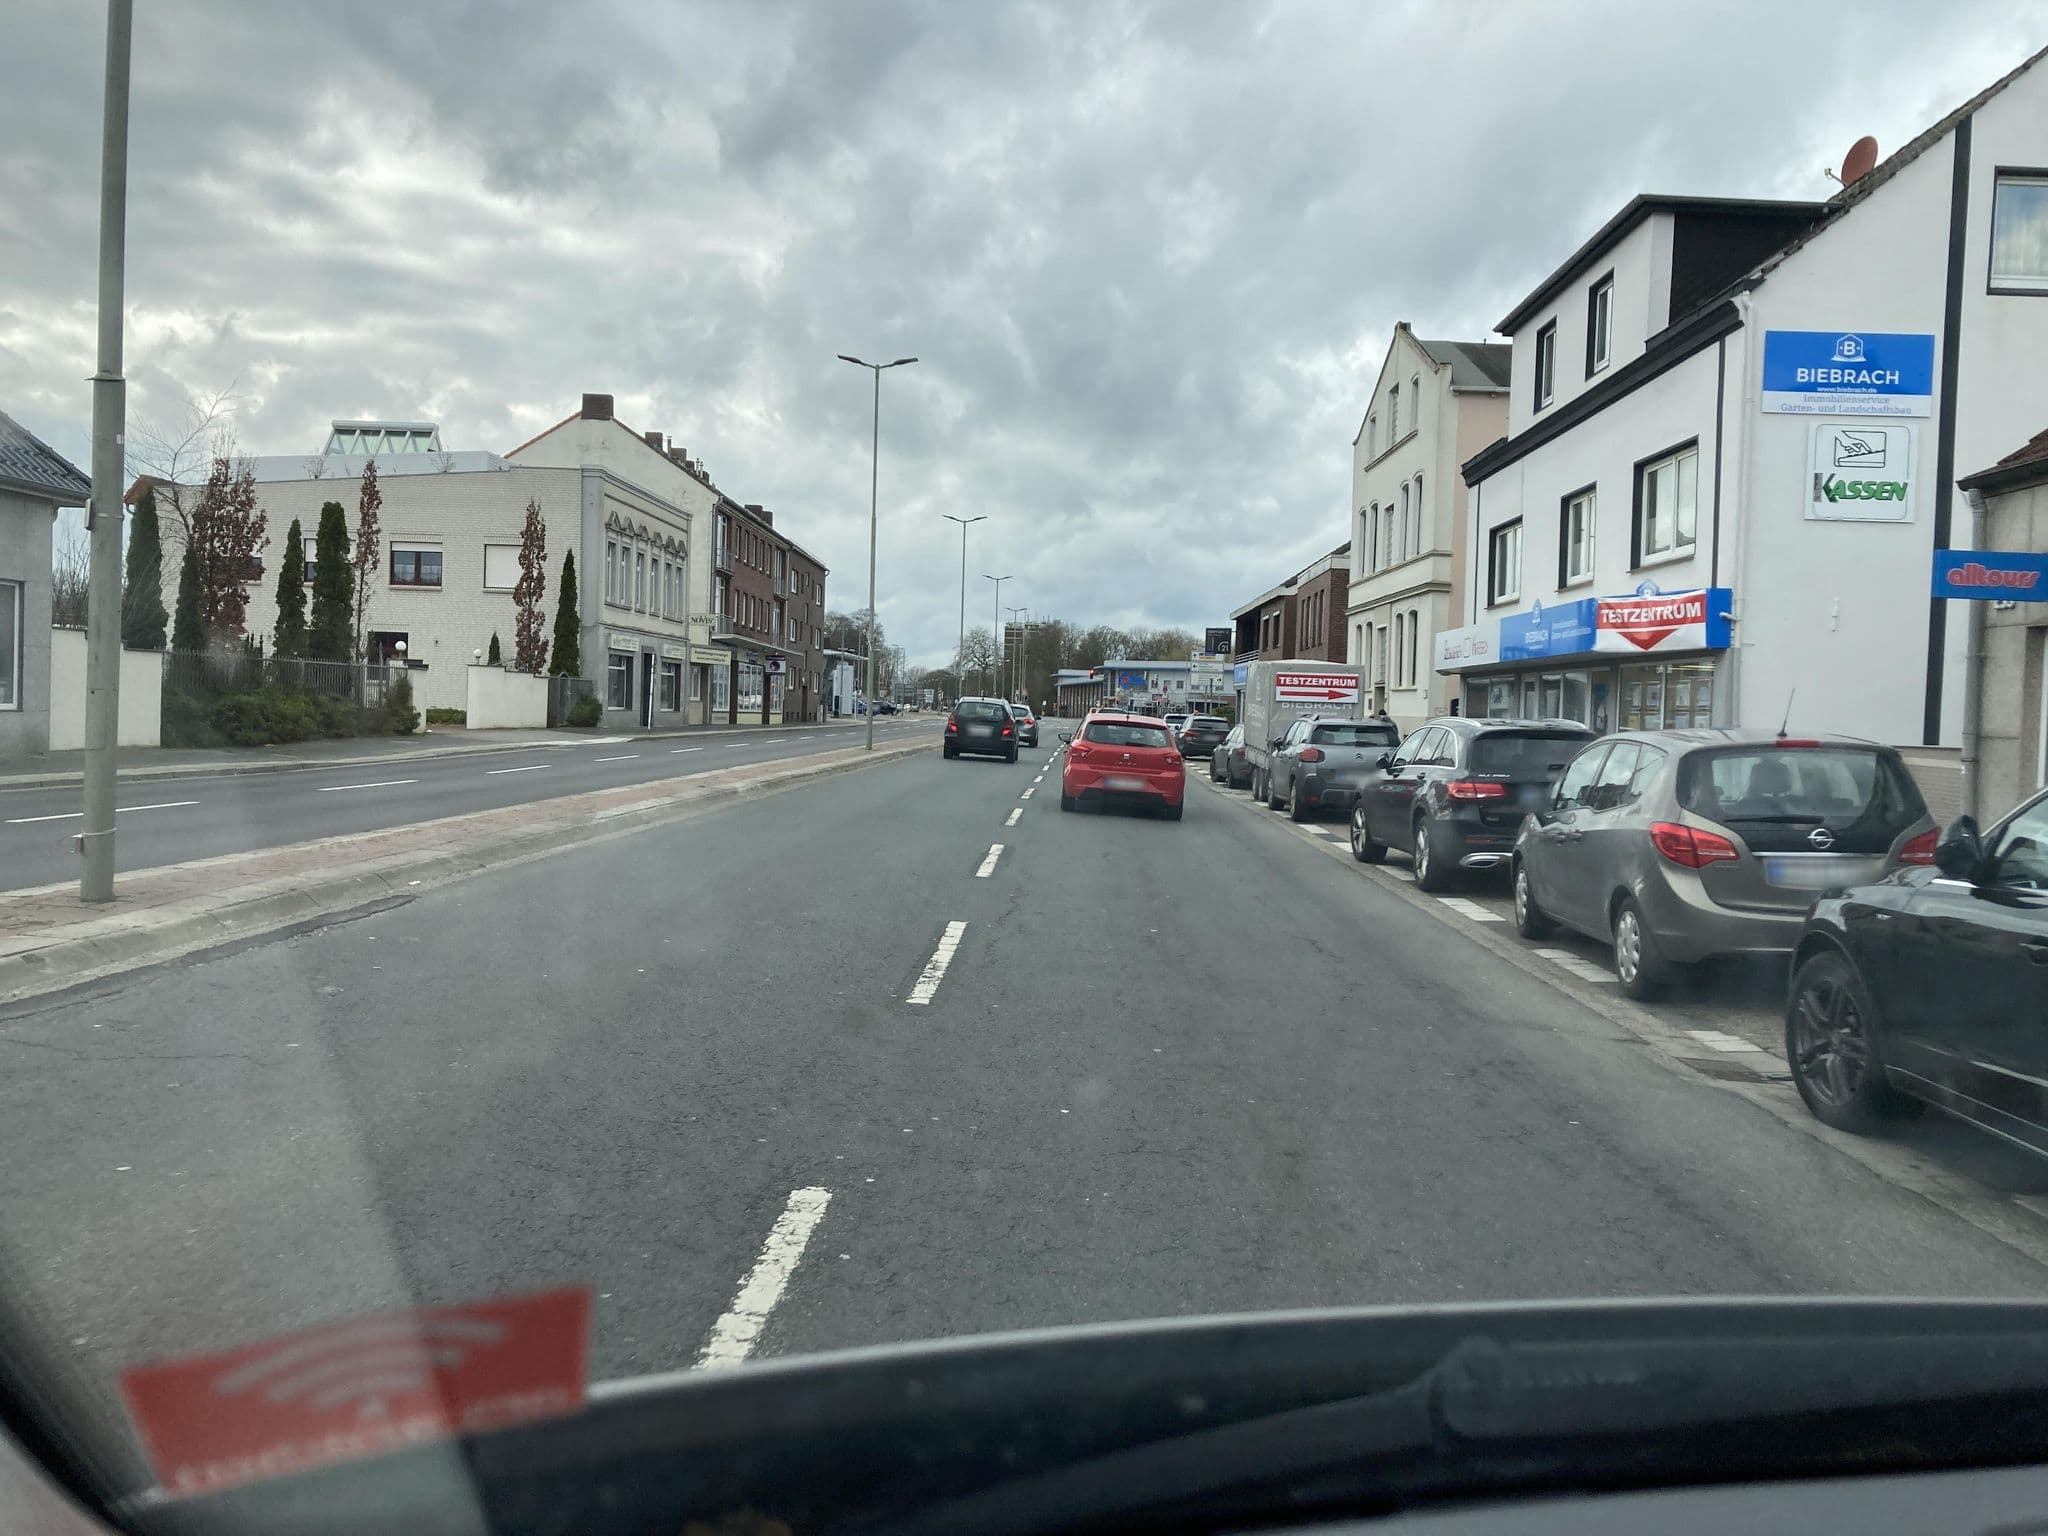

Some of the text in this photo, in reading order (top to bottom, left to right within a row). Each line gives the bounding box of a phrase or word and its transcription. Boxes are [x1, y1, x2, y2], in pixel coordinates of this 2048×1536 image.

[1796, 368, 1900, 385] BIEBRACH
[1803, 394, 1891, 404] Immobilienservice
[1780, 403, 1912, 415] Garten- und Landschaftsbau
[1946, 563, 2041, 590] alltours
[1601, 601, 1702, 624] TESTZENTRUM
[1279, 676, 1357, 687] TESTZENTRUM
